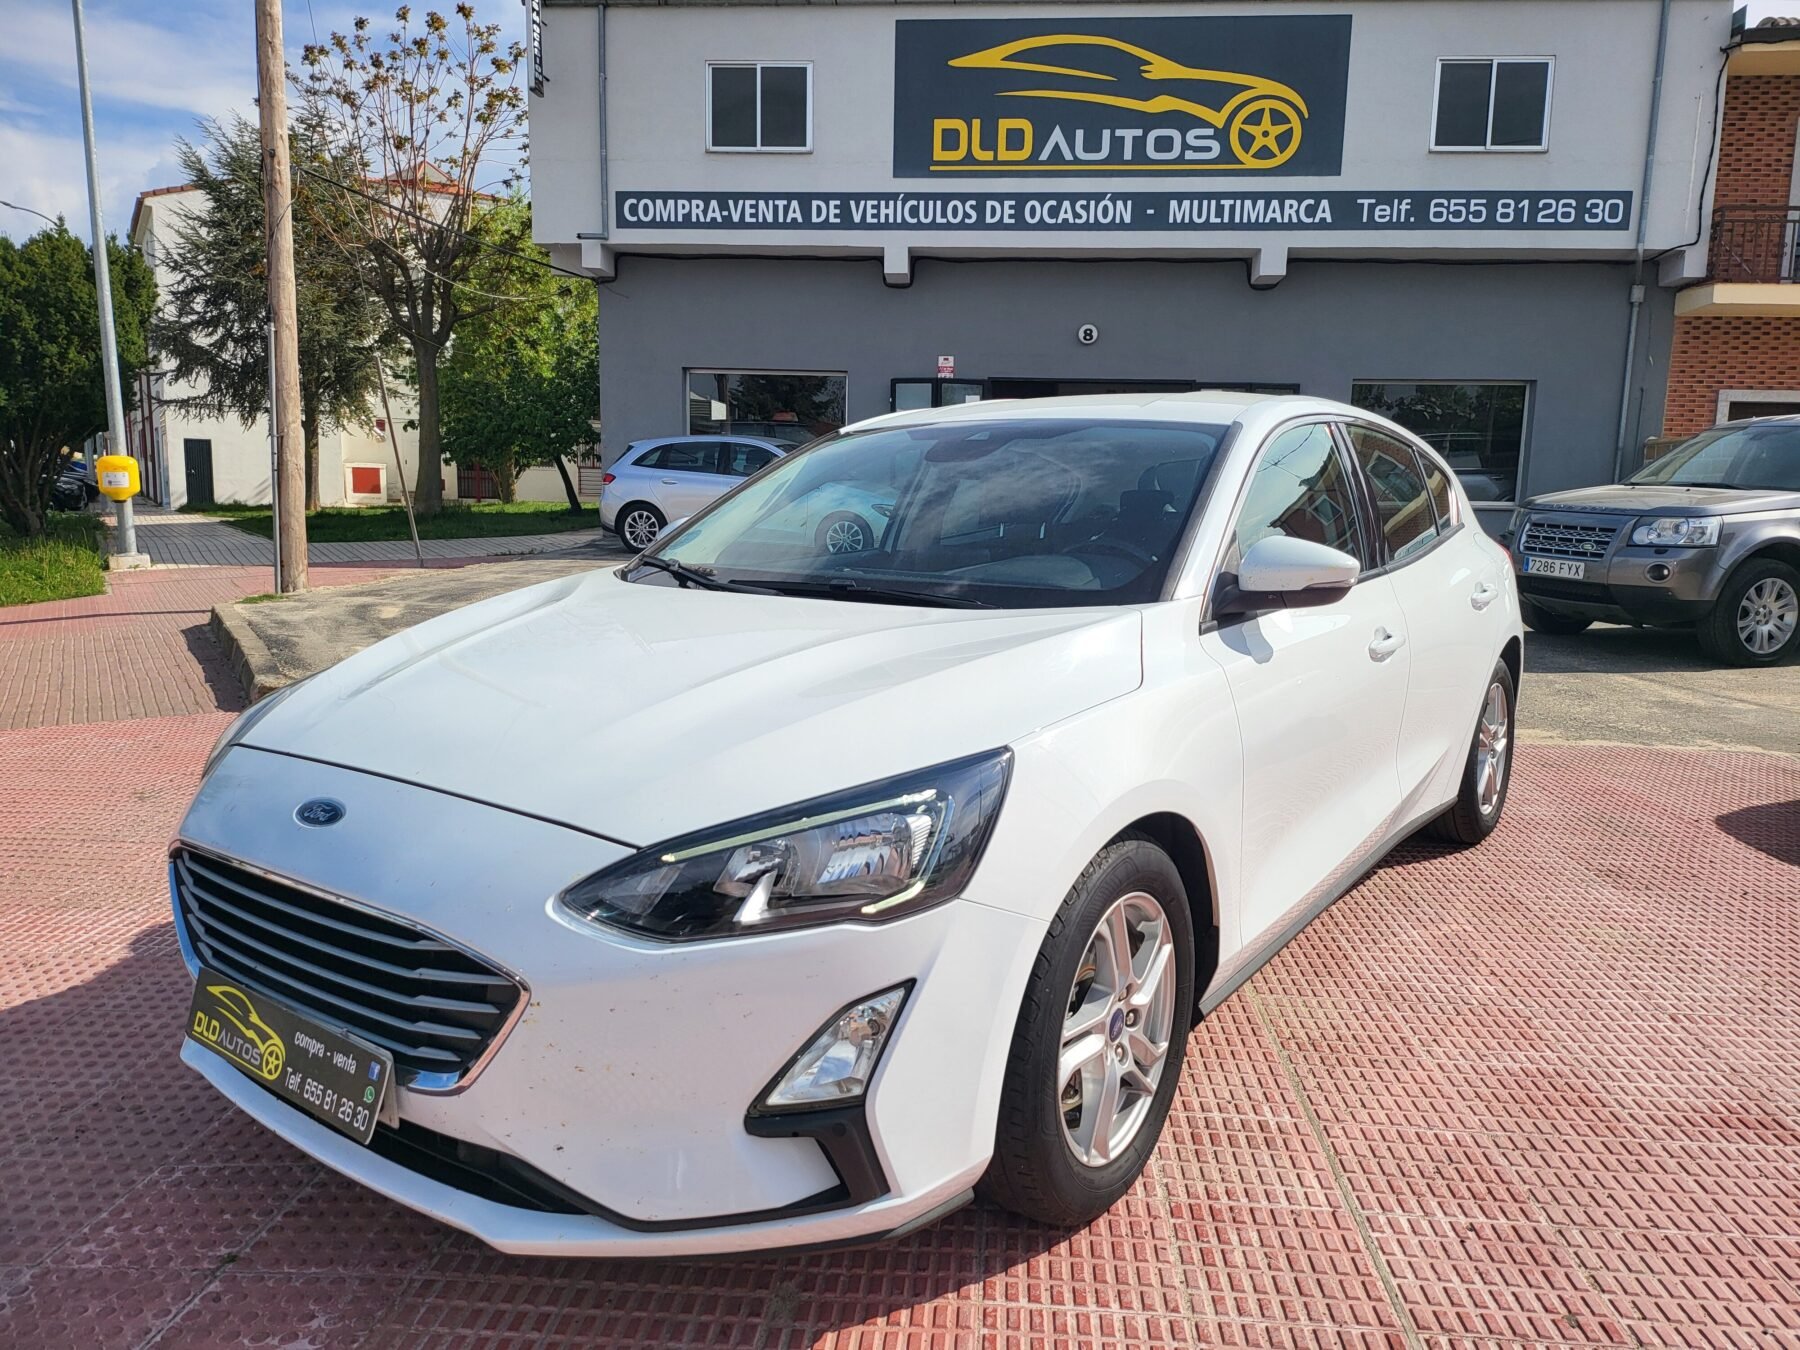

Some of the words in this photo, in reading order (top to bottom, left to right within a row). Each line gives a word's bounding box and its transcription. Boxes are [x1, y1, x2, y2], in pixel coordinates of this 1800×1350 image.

[623, 198, 803, 223] COMPRA-VENTA
[811, 199, 842, 223] DE
[849, 194, 978, 224] VEHÍCULOS
[985, 200, 1016, 223] DE
[1024, 193, 1132, 224] OCASIÓN
[1168, 198, 1333, 224] MULTIMARCA
[1356, 198, 1416, 223] Telf.
[1429, 198, 1487, 223] 655
[1495, 198, 1531, 223] 81
[1536, 198, 1577, 223] 26
[1584, 198, 1624, 224] 30
[1083, 328, 1094, 342] 8
[1530, 559, 1556, 574] 7286
[1559, 562, 1582, 577] FYX
[304, 803, 336, 822] Ford
[294, 1031, 325, 1059] compra
[333, 1051, 357, 1075] venta
[284, 1066, 301, 1094] Telf.
[303, 1078, 324, 1105] 655
[323, 1089, 338, 1113] 81
[338, 1098, 353, 1123] 26
[353, 1107, 370, 1131] 30
